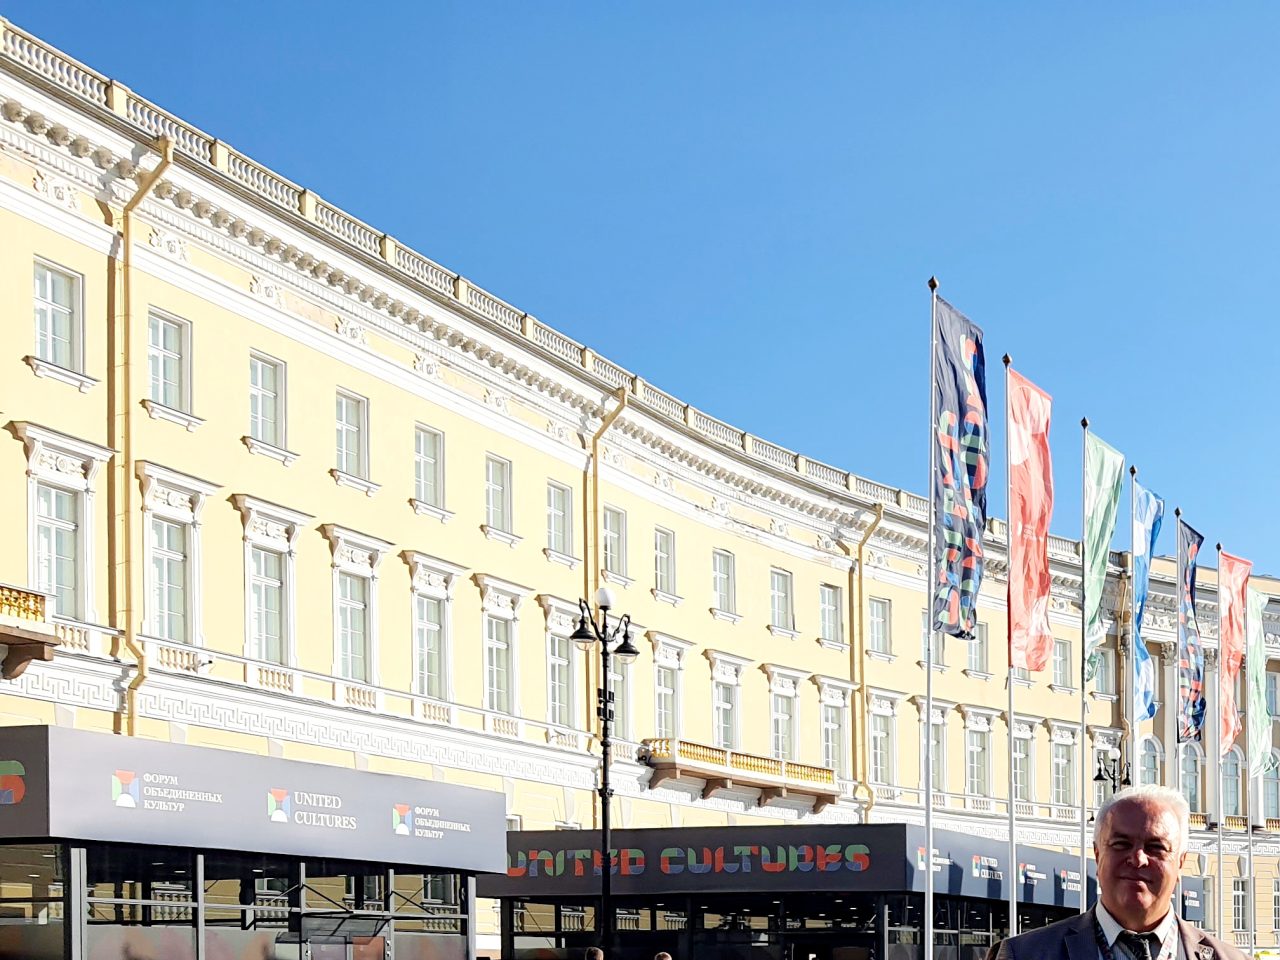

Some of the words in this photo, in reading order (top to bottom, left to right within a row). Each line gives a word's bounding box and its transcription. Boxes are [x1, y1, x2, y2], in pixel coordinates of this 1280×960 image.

[143, 773, 178, 785] ФОРУМ
[143, 787, 223, 803] ОБЪЕДИНЕННЫХ
[294, 791, 342, 809] UNITED
[143, 799, 185, 812] КУЛЬТУР
[414, 806, 440, 817] ФОРУМ
[294, 811, 357, 830] CULTURES
[414, 828, 444, 839] КУЛЬТУР
[660, 844, 872, 875] CULTURES
